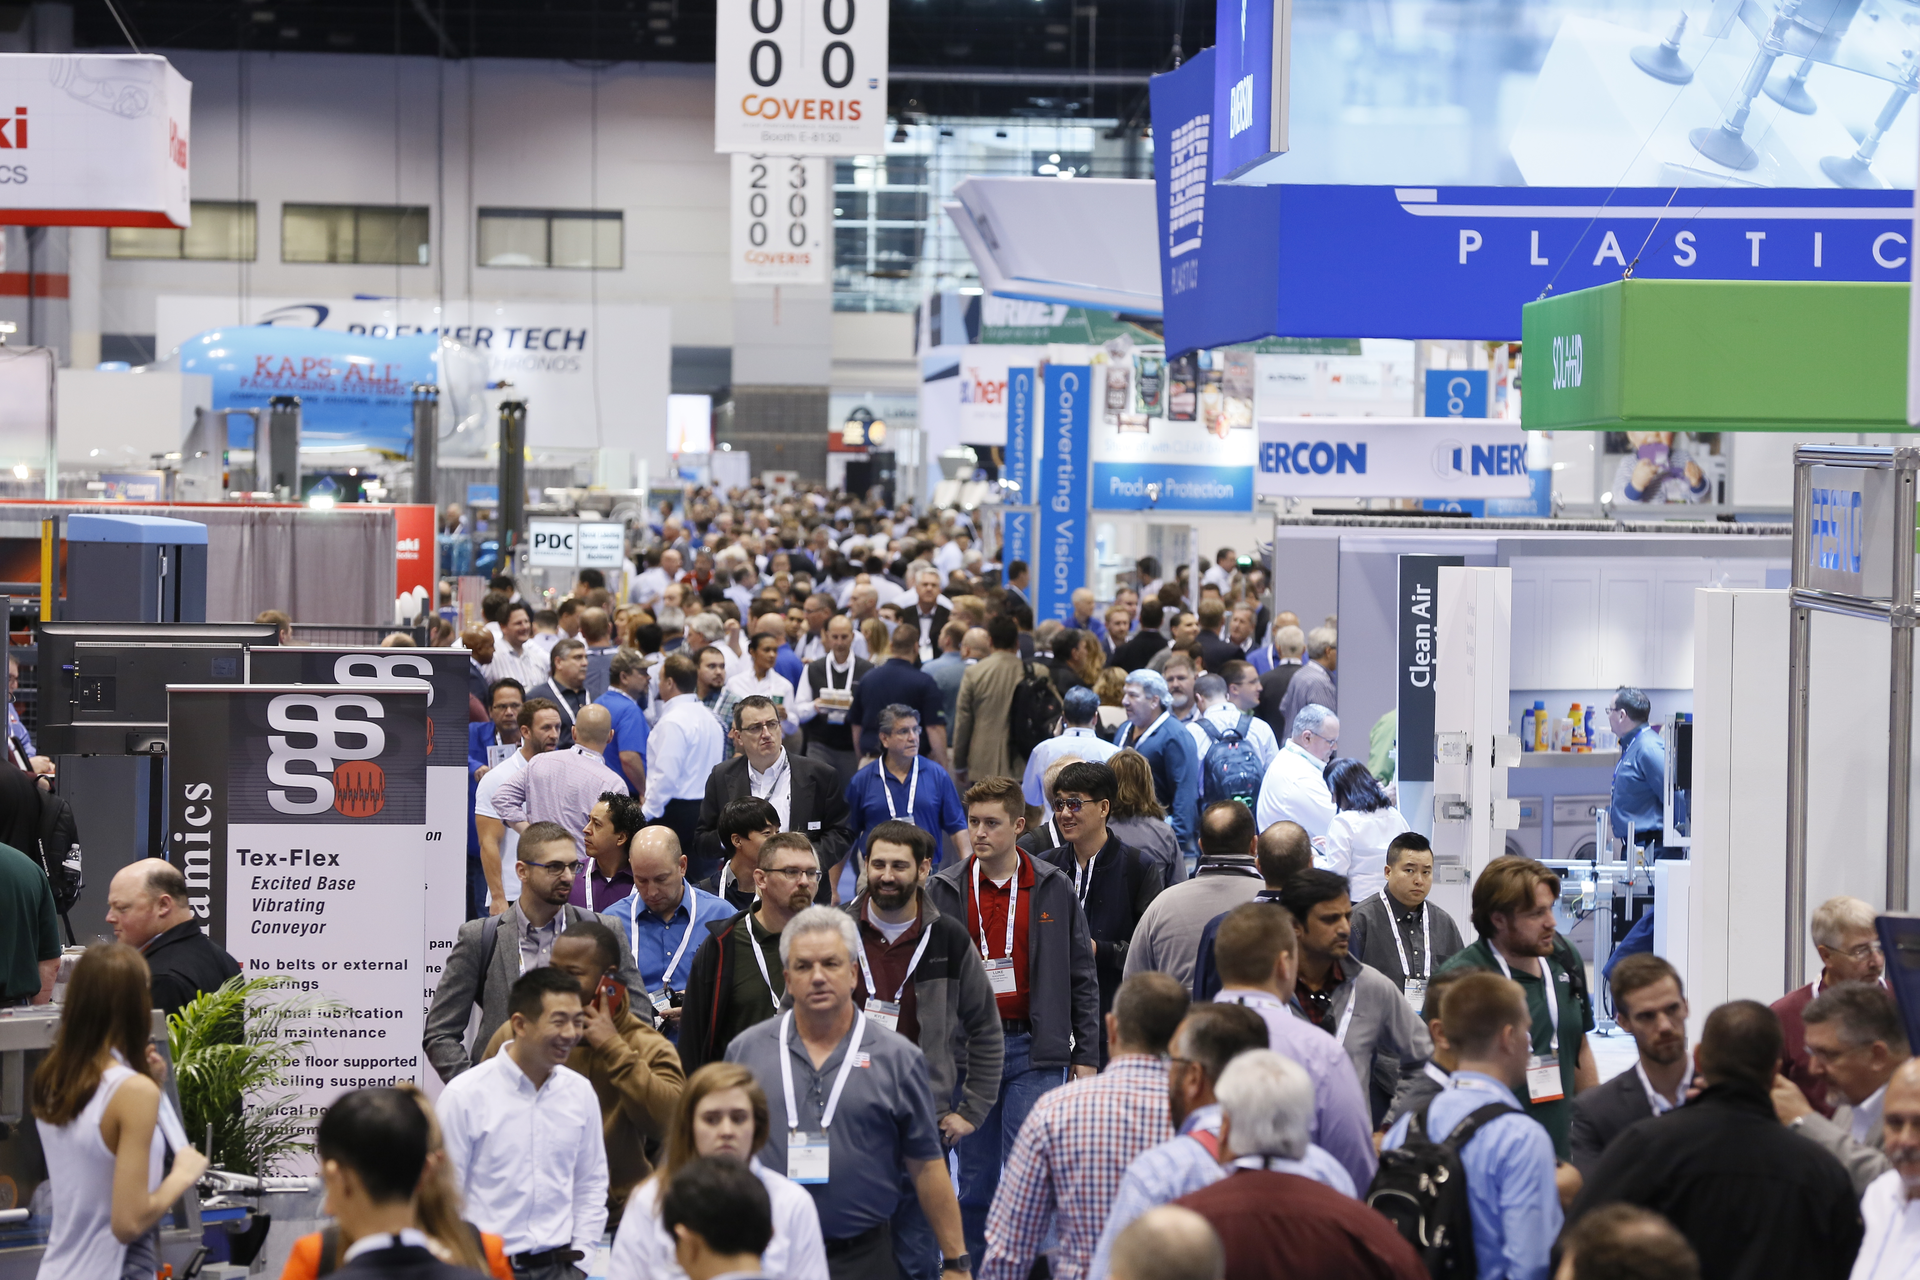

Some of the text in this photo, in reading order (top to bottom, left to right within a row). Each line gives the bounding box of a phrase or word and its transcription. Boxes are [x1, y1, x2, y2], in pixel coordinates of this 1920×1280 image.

[741, 93, 862, 121] COVERIS
[760, 131, 797, 142] Booth
[749, 155, 768, 247] 200
[789, 156, 807, 248] 300
[1458, 229, 1908, 269] PLASTIC
[503, 327, 588, 351] TECH
[254, 354, 399, 384] KAPS-ALL
[490, 355, 580, 374] HRONOS
[1447, 376, 1472, 418] Co
[1051, 371, 1079, 512] Converting
[1109, 476, 1234, 499] Prodt Protection
[535, 533, 573, 550] PDC
[1011, 514, 1027, 561] Visi
[1810, 487, 1863, 574] FESTO
[1053, 519, 1075, 595] Vision
[1408, 583, 1431, 688] Clean Air
[173, 782, 213, 939] amics
[235, 848, 341, 867] Tex-Flex
[251, 876, 356, 891] Excited Base
[251, 897, 327, 916] Vibrating
[250, 920, 327, 937] Conveyor
[249, 958, 409, 971] No belts or external
[317, 1006, 404, 1019] lubrication
[284, 1025, 387, 1038] maintenance
[305, 1055, 339, 1068] floor
[343, 1055, 418, 1070] supported
[270, 1074, 324, 1089] ceiling
